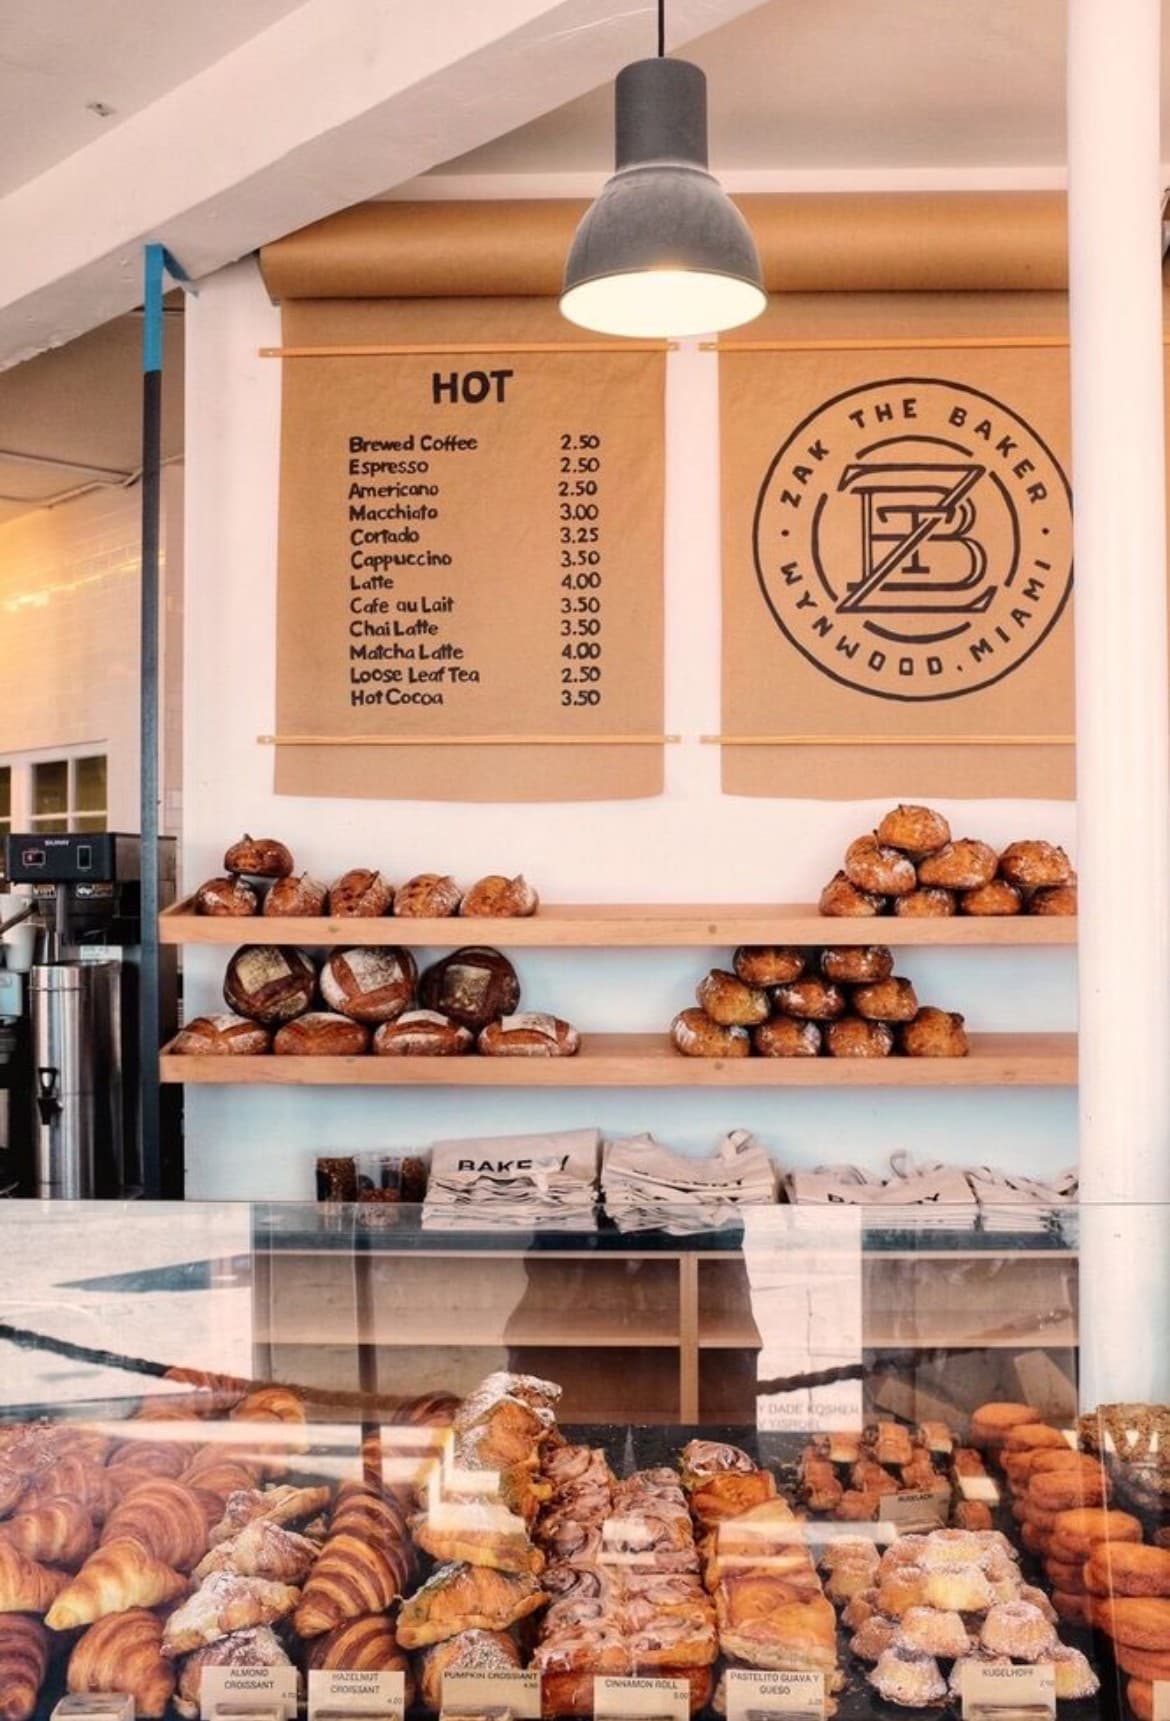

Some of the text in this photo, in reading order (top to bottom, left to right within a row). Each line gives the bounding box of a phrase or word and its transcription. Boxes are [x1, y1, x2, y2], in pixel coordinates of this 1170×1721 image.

[433, 370, 513, 404] HOT
[350, 434, 600, 453] Brewed Coffee 2.50
[780, 398, 1048, 508] ZAK THE BAKER
[349, 457, 600, 477] Espresso 2.50
[348, 481, 597, 499] Americano 2.50
[350, 503, 598, 520] Macchiato 3.00
[351, 527, 598, 546] Cortado 3.25
[351, 550, 600, 572] Cappuccino 3.50
[351, 572, 601, 590] Latte 4.00
[350, 597, 600, 614] Cafe au Lait 3.50
[968, 559, 1051, 662] MIAMI
[350, 619, 600, 637] Chai Latte 3.50
[350, 643, 600, 659] Matcha Latte 4.00
[351, 666, 601, 683] Loose Leaf Tea 2.50
[352, 688, 600, 706] Hot Cocoa 3.50
[230, 1668, 269, 1677] ALMOND
[331, 1672, 379, 1681] HAZELNUT
[730, 1672, 819, 1682] PASTELITO GUAVA Y
[224, 1680, 275, 1689] CROISSANT
[330, 1684, 380, 1693] CROISSANT
[604, 1679, 677, 1689] CINNAMON ROLL
[759, 1684, 791, 1695] QUESO
